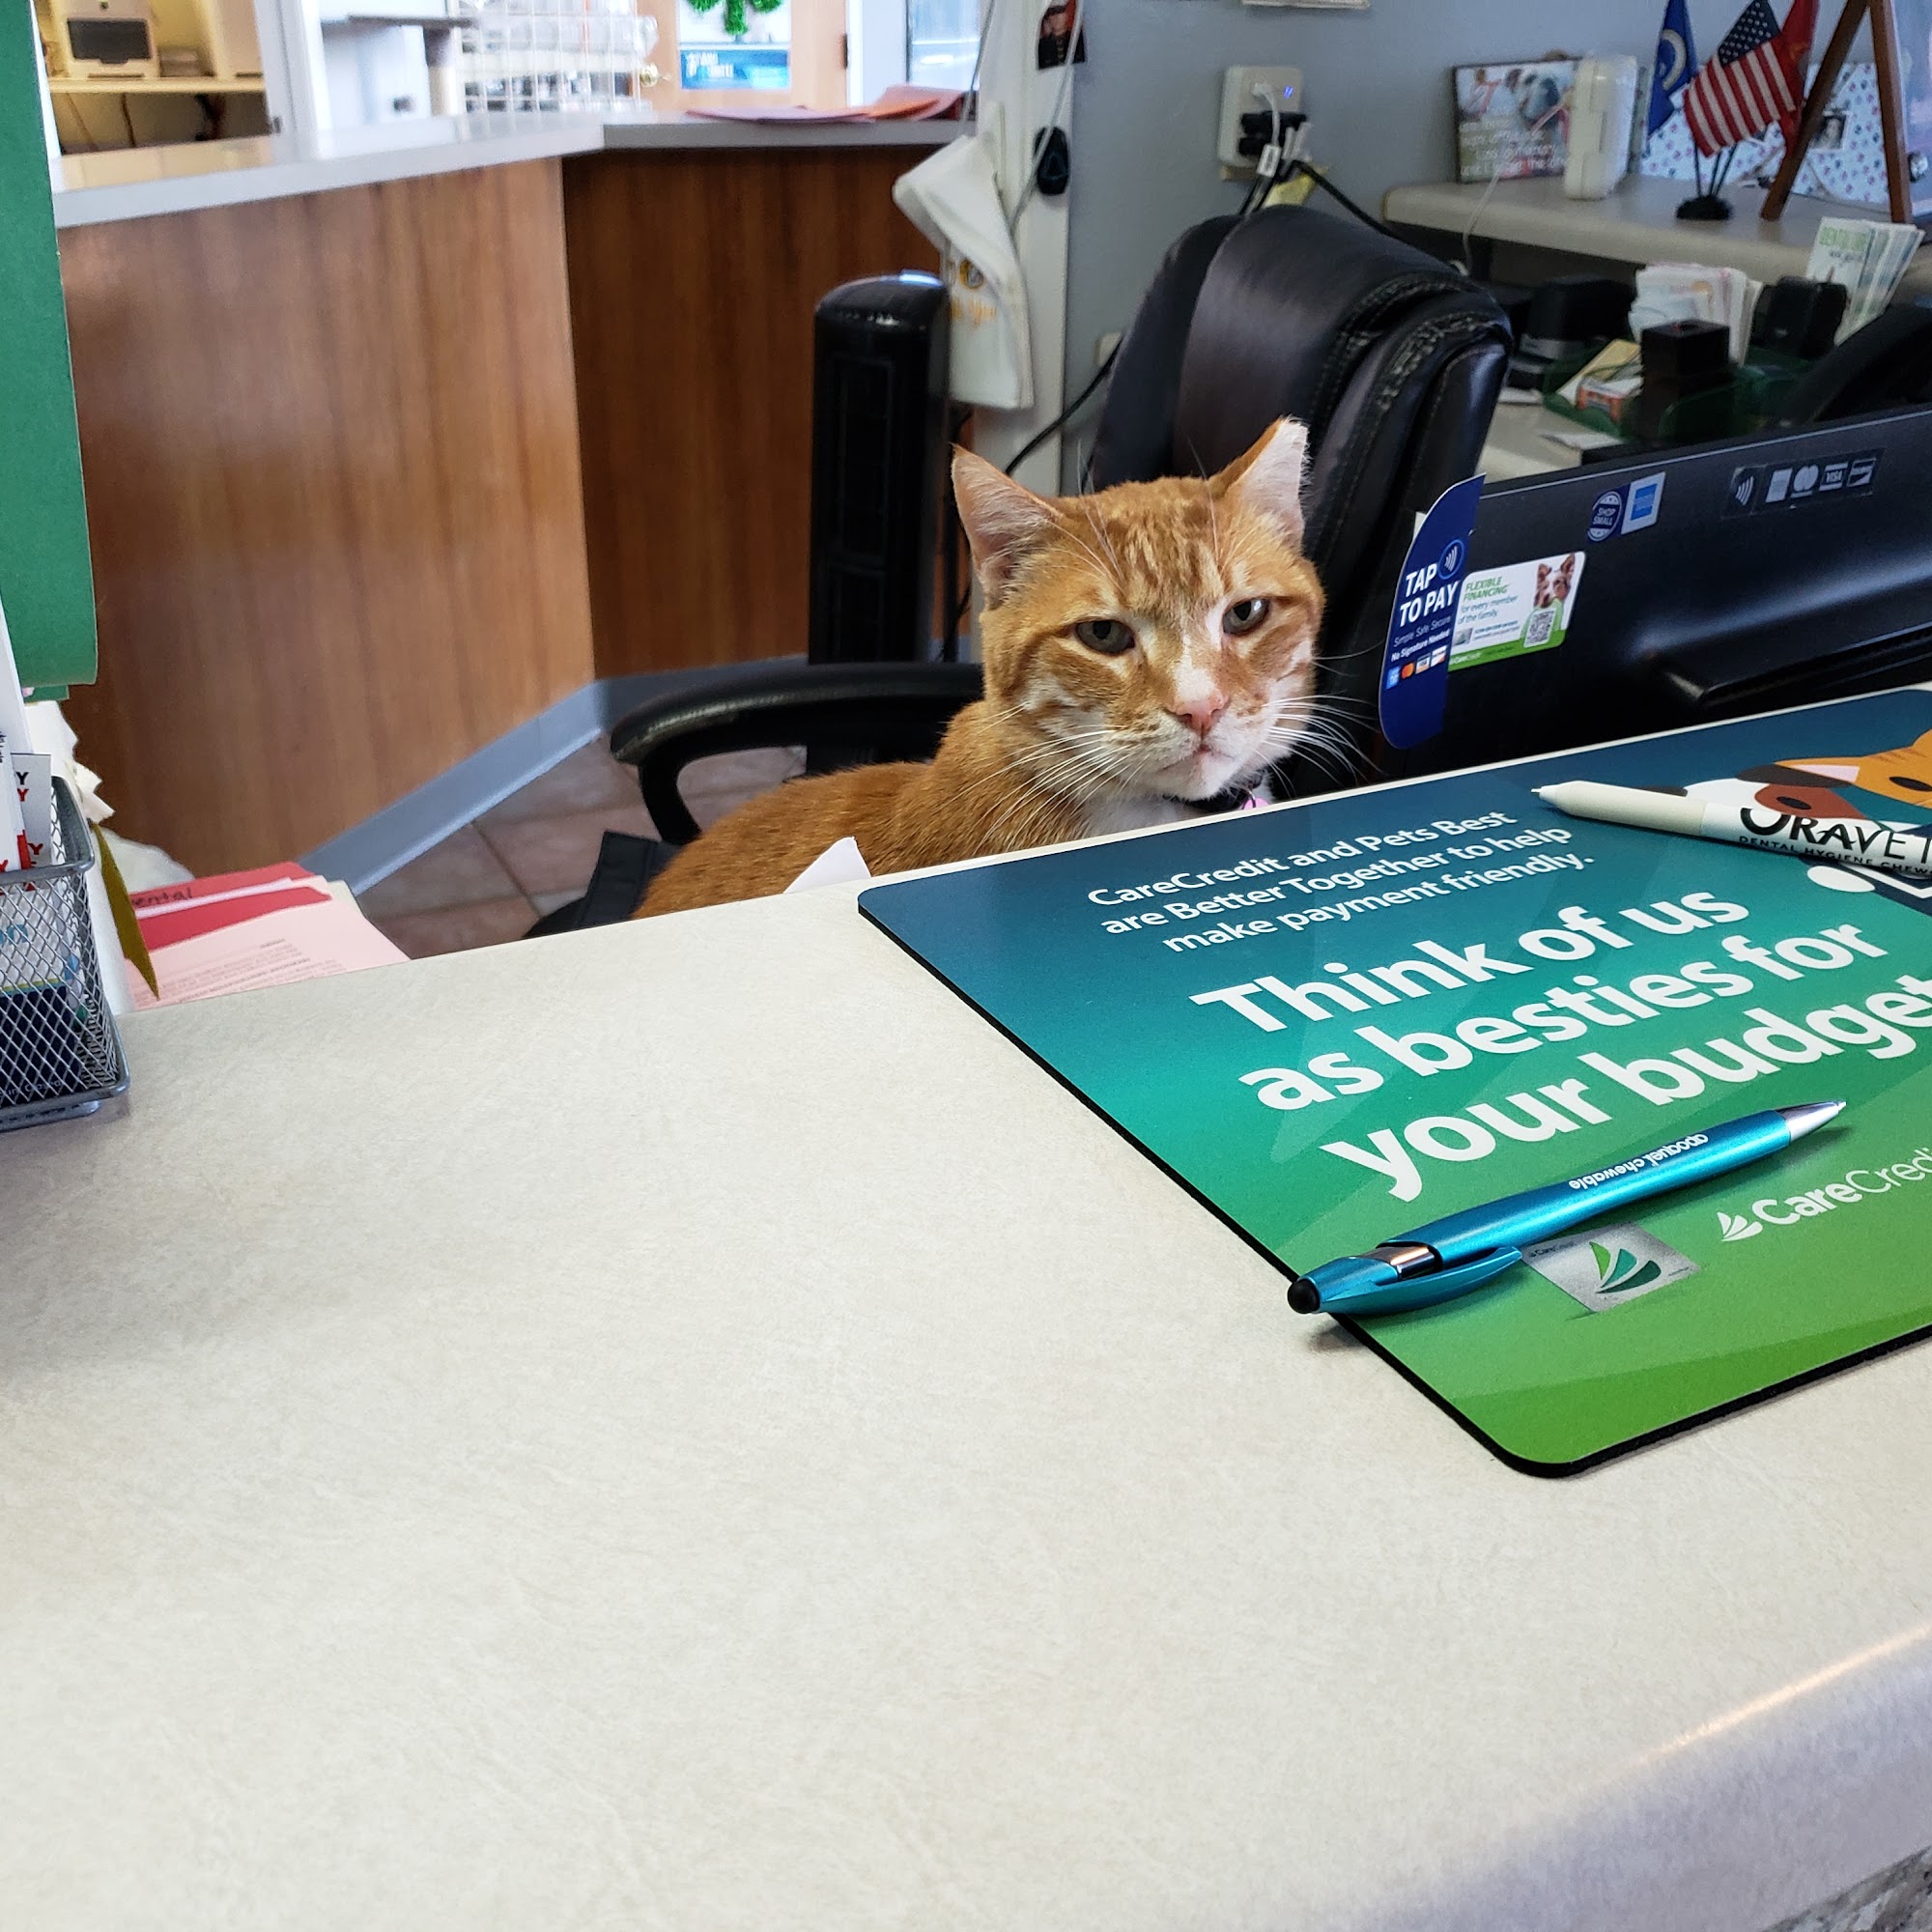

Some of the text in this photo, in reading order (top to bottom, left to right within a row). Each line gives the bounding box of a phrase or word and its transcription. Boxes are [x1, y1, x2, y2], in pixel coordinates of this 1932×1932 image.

[1399, 580, 1460, 628] TO PAY
[1405, 562, 1437, 598] TAP
[1463, 585, 1510, 601] FINANCING
[1465, 577, 1502, 591] FLEXIBLE
[1088, 810, 1520, 907] CareCredit and Pets Best
[1100, 826, 1574, 934] are Better Together to help
[1740, 835, 1932, 875] DENTAL HYGIENE CHEW
[1162, 851, 1596, 952] make payment friendly.
[1188, 889, 1749, 1033] Think of us
[1237, 923, 1889, 1111] as besties for
[1318, 1076, 1613, 1204] your
[1568, 1134, 1709, 1190] apoquel chewable
